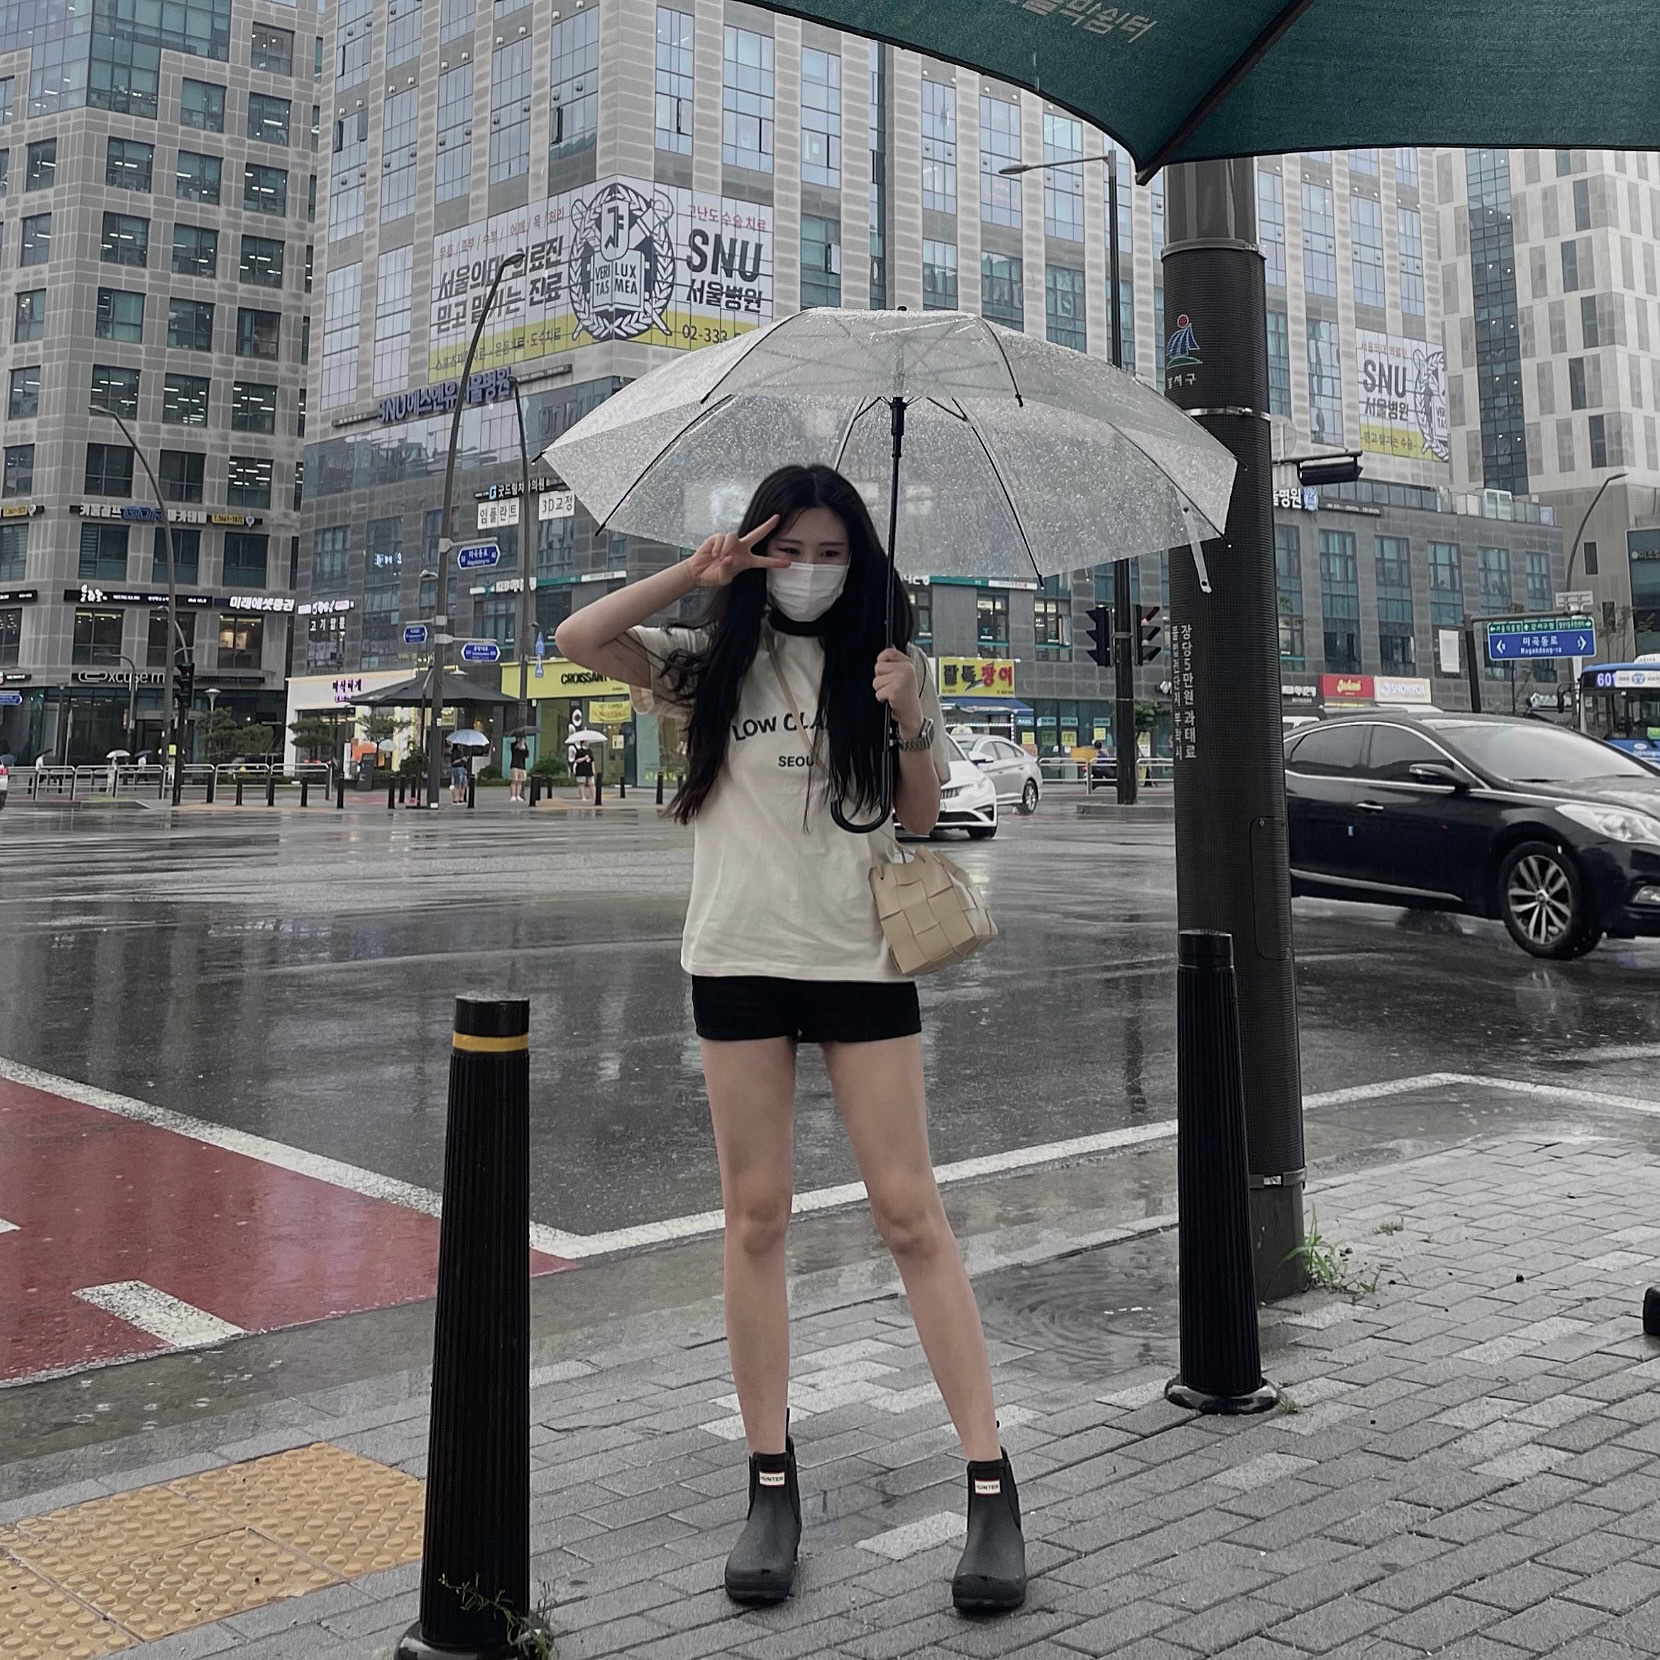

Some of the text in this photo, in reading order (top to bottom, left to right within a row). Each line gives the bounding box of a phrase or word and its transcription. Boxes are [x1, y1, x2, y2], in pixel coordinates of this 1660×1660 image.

[687, 228, 763, 282] SNU
[595, 262, 610, 279] VERI
[615, 261, 637, 279] LUX
[596, 280, 610, 297] TAS
[614, 280, 638, 296] MEA
[686, 279, 762, 313] 서울병원
[437, 300, 467, 334] 믿고
[529, 271, 563, 307] 진료
[1363, 359, 1407, 398] SNU
[379, 366, 512, 422] SNU에스엔유울병원
[1364, 397, 1409, 421] 서울병원
[498, 477, 545, 498] 굿드림치의원
[229, 596, 295, 612] 미래에셋증권
[1522, 635, 1558, 647] 마곡동로
[151, 672, 166, 684] m
[731, 715, 777, 741] LOW
[778, 755, 815, 768] SEOU
